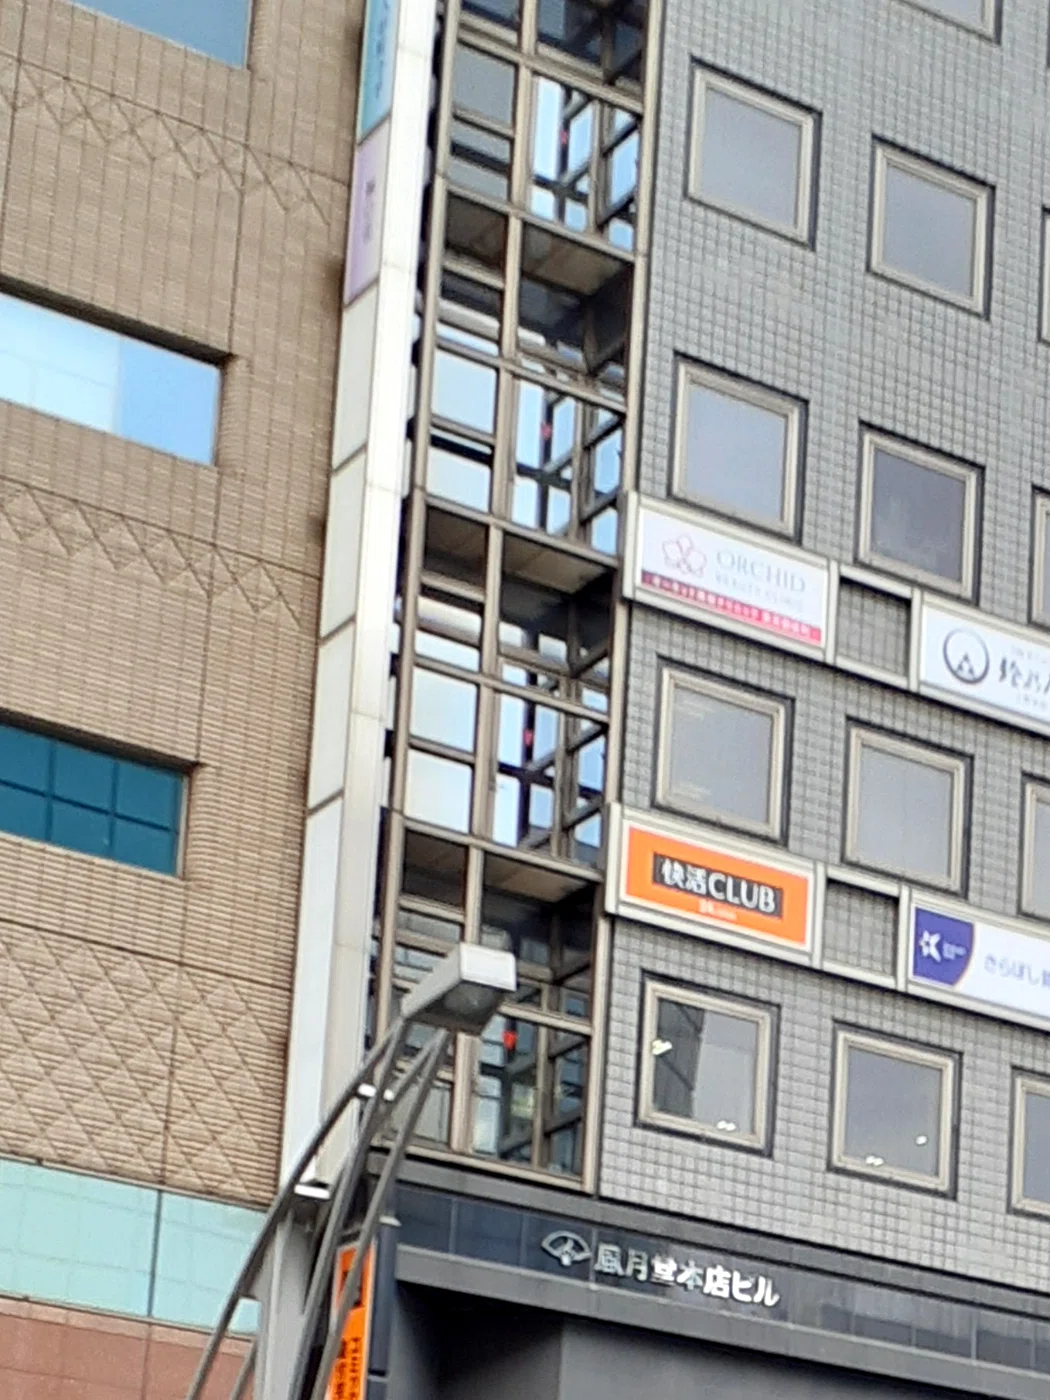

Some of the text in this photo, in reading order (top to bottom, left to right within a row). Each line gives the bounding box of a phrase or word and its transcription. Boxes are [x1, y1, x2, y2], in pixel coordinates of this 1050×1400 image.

[716, 550, 806, 592] ORCHID
[661, 858, 776, 913] 快活CLUB
[594, 1242, 781, 1307] 風月堂本店ビル
